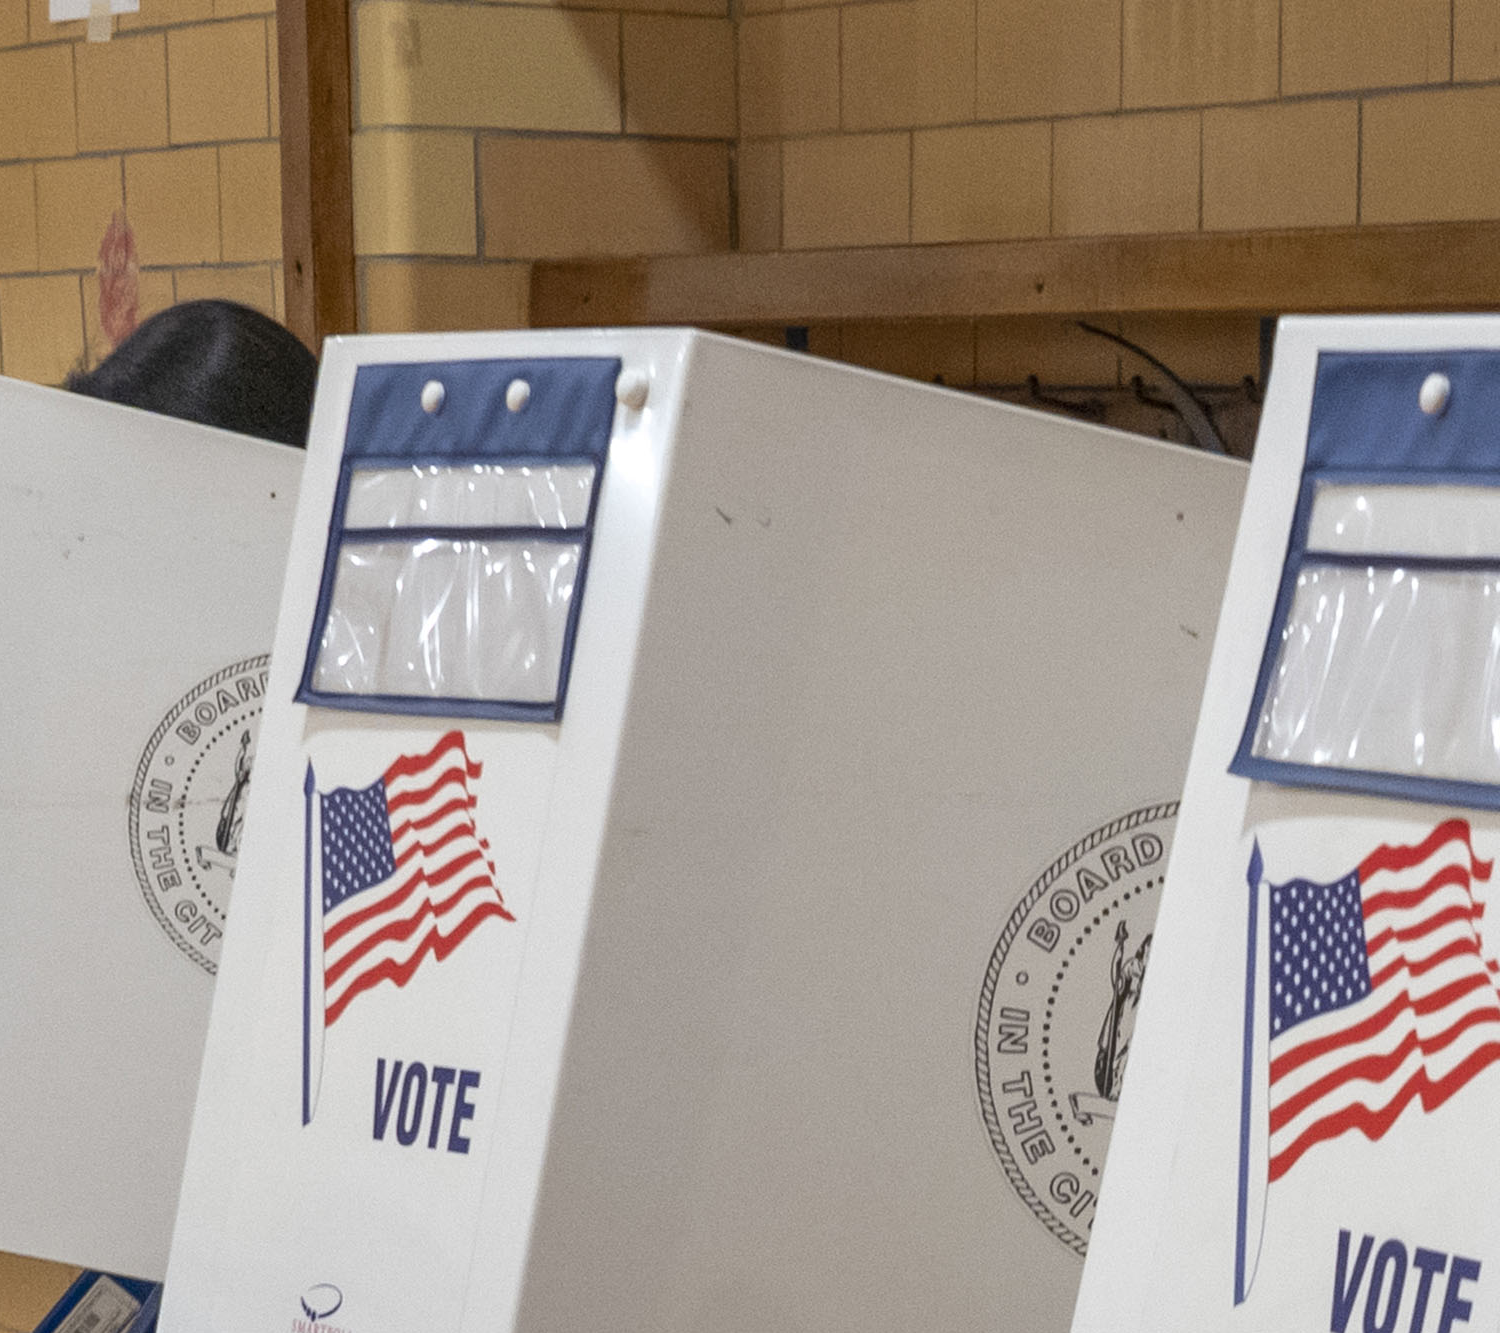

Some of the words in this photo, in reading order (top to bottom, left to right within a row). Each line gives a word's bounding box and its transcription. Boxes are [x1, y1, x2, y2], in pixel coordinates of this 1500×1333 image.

[146, 778, 173, 813] IN
[147, 825, 182, 892] THE
[1027, 832, 1164, 952] BOARD
[997, 1007, 1030, 1054] IN
[373, 1057, 481, 1154] VOTE
[1003, 1071, 1056, 1166] THE
[1050, 1172, 1097, 1231] CI
